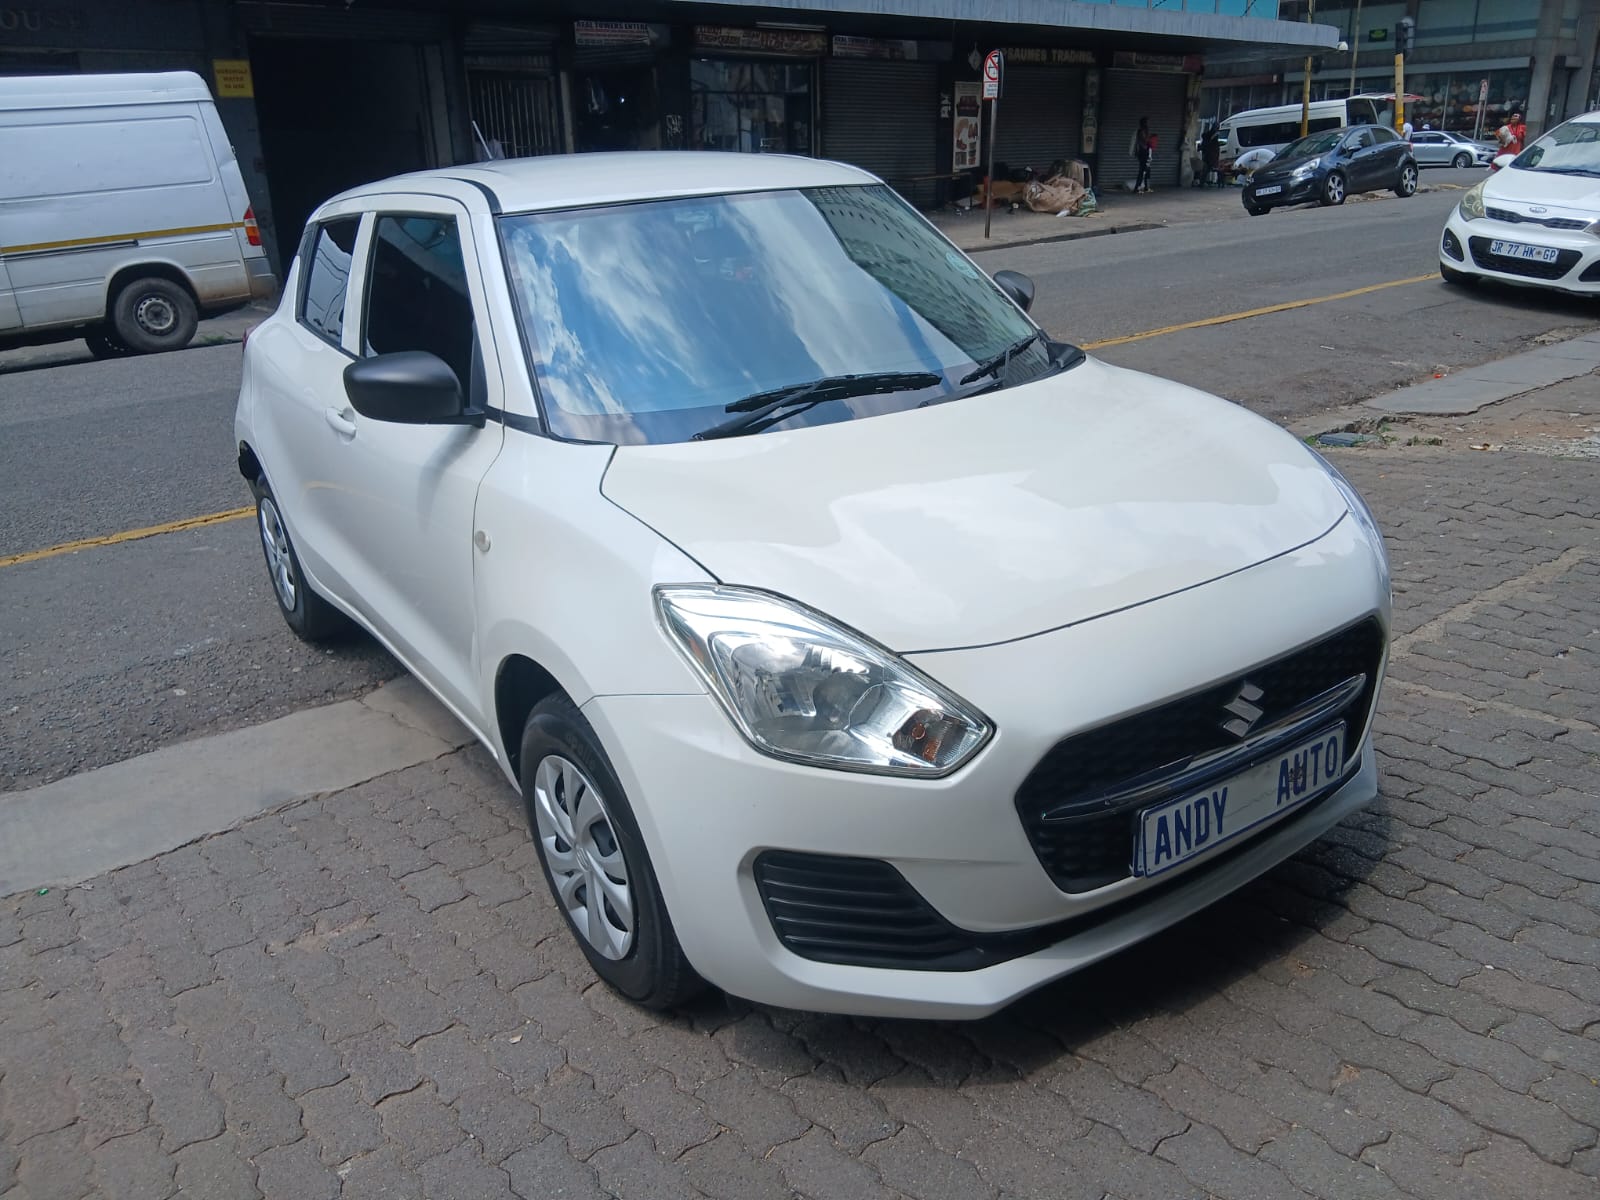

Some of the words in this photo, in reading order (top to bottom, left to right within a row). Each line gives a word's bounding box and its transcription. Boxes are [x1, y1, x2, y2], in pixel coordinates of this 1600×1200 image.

[1492, 241, 1504, 253] JR
[1507, 243, 1520, 256] 77
[1522, 245, 1536, 258] HK
[1543, 248, 1557, 261] GP
[1154, 786, 1228, 866] ANDY
[1276, 735, 1339, 807] AUTO
